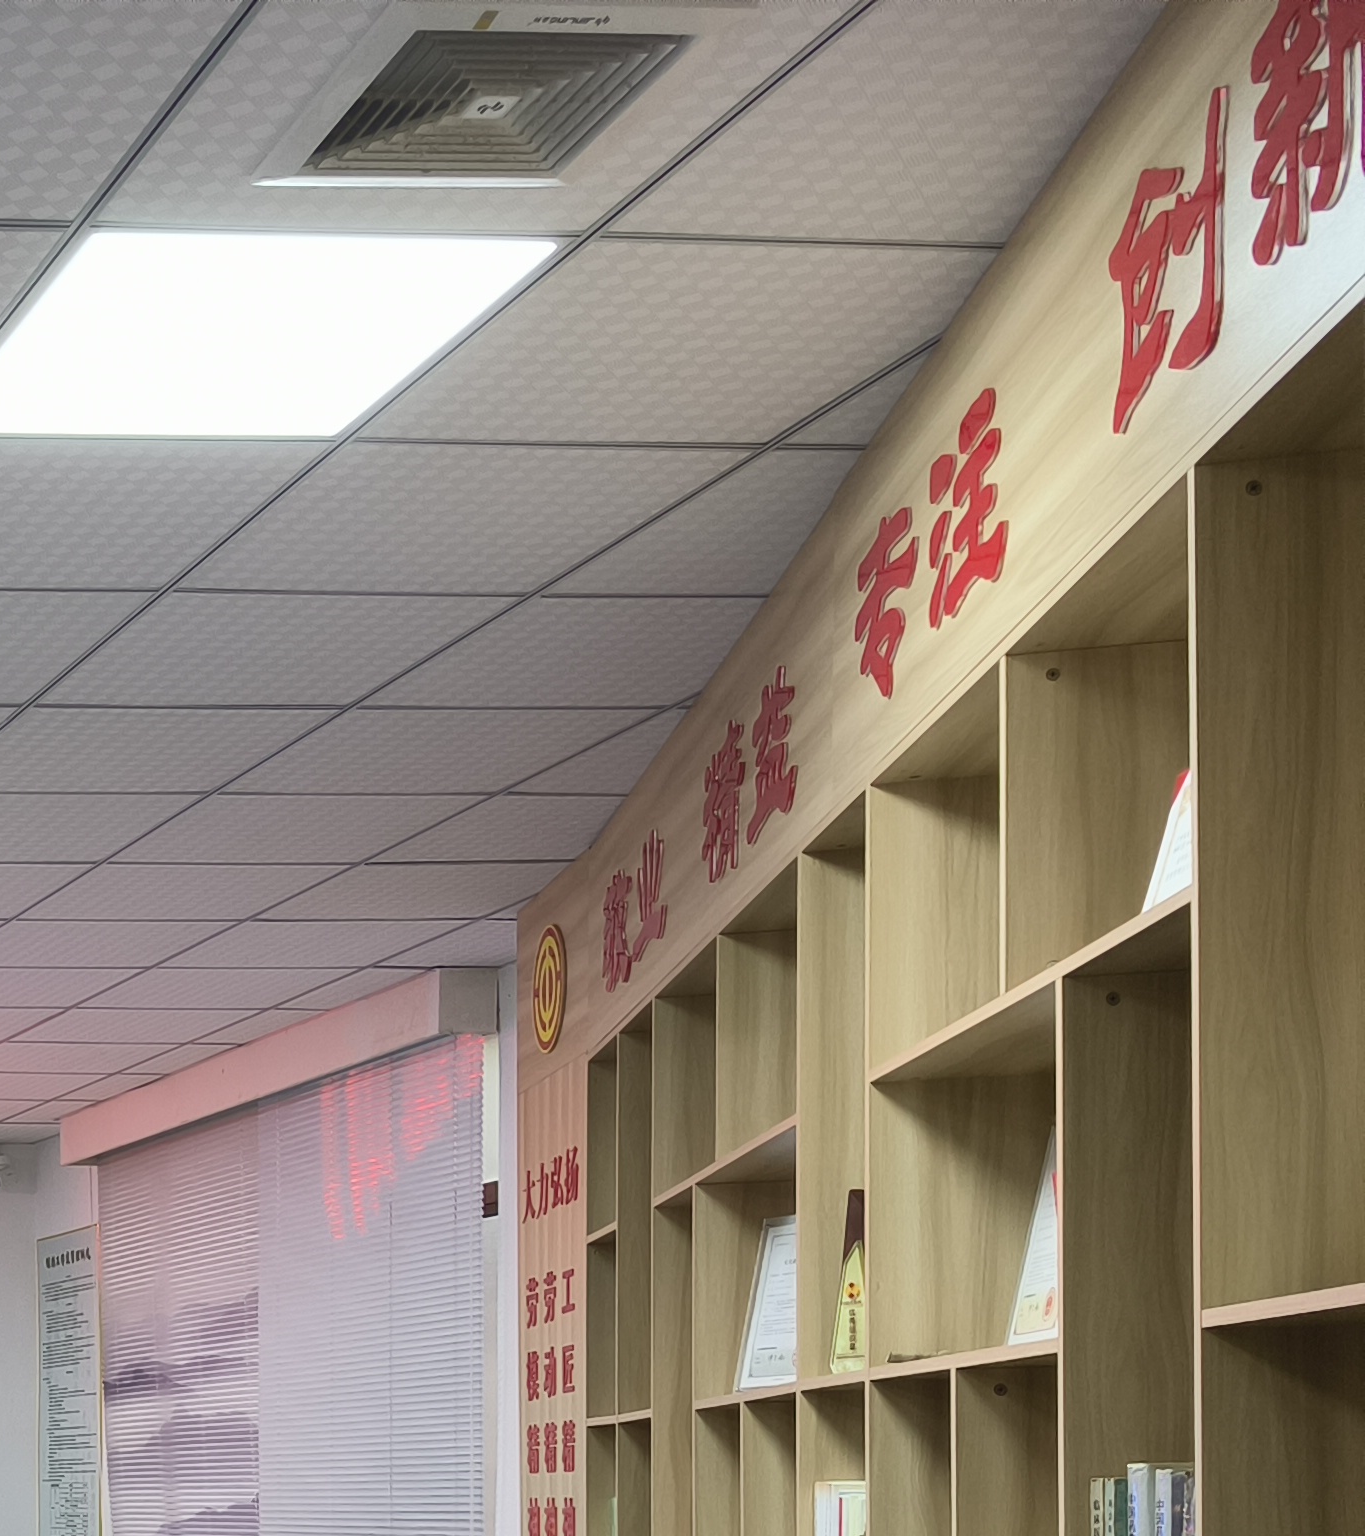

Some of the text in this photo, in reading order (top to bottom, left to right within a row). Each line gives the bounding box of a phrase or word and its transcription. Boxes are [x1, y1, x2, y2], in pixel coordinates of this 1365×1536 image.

[853, 387, 1009, 698] 专注
[522, 1146, 580, 1225] 大力弘扬
